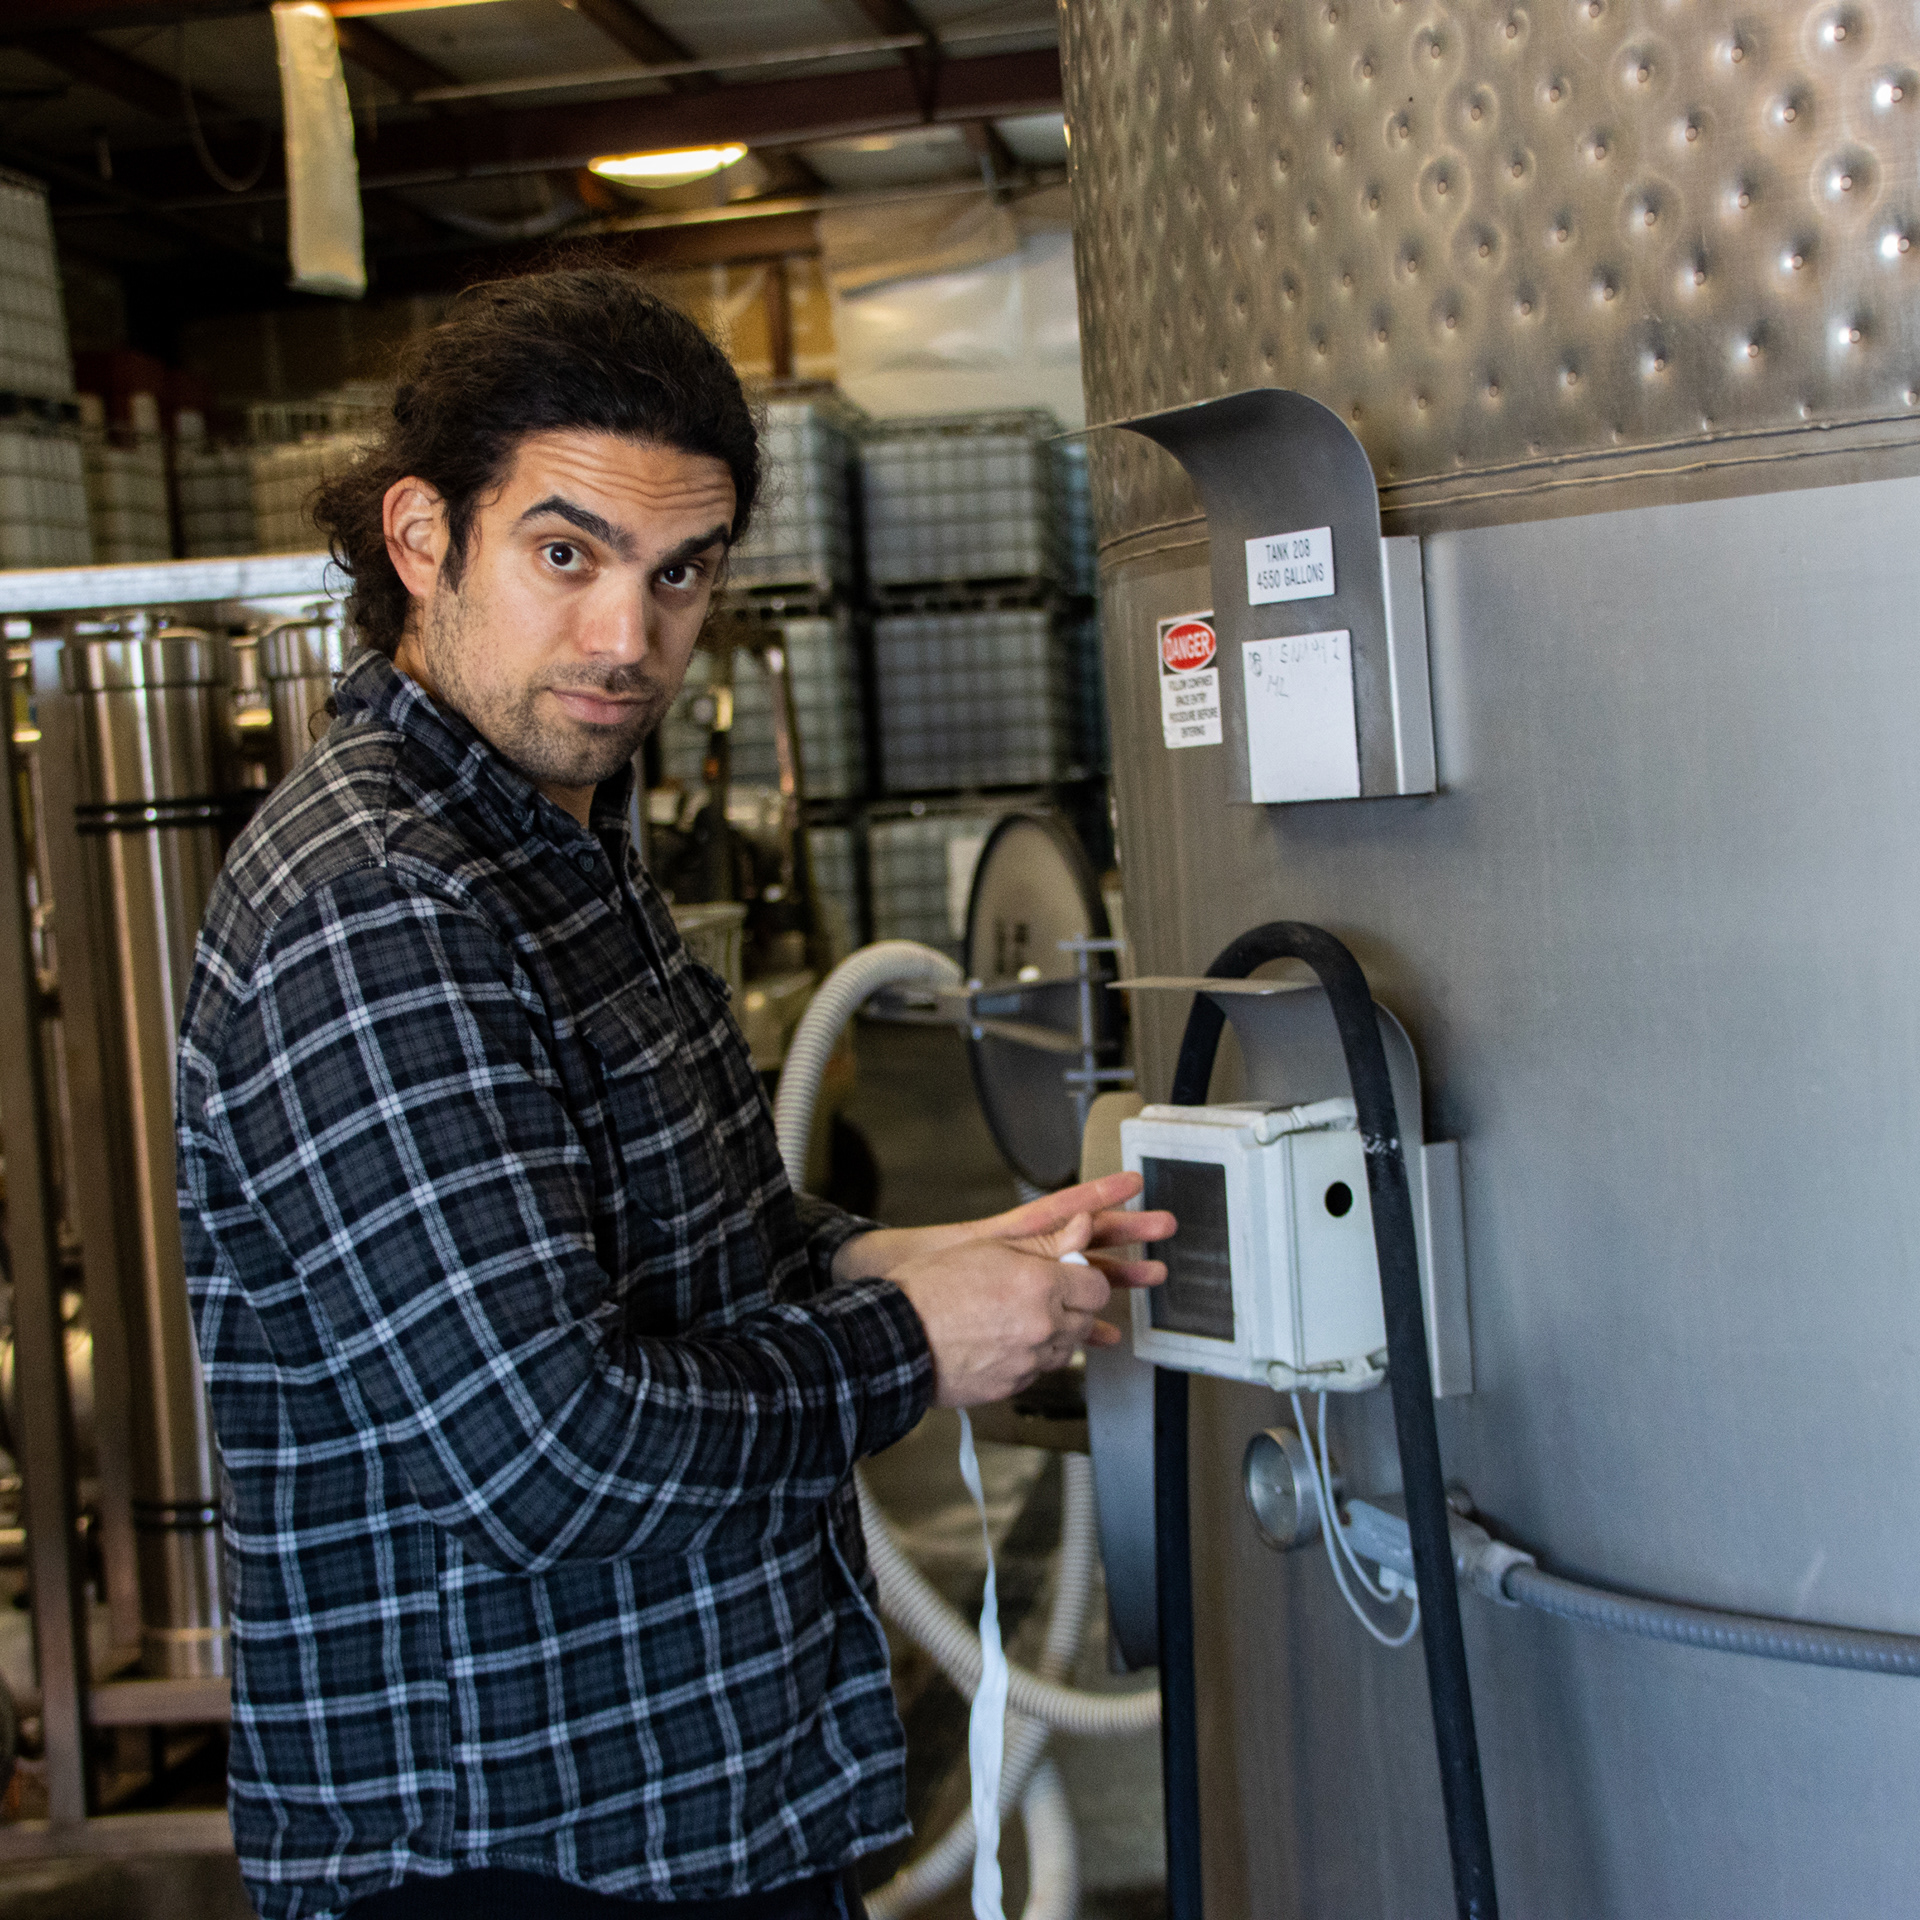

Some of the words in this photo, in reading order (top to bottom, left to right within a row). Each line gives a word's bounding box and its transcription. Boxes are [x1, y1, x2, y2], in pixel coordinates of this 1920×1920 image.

[1266, 542, 1289, 563] TANK
[1292, 538, 1311, 559] 208
[1257, 569, 1281, 591] 4550
[1284, 562, 1325, 587] GALLONS
[1164, 630, 1211, 662] DANGER
